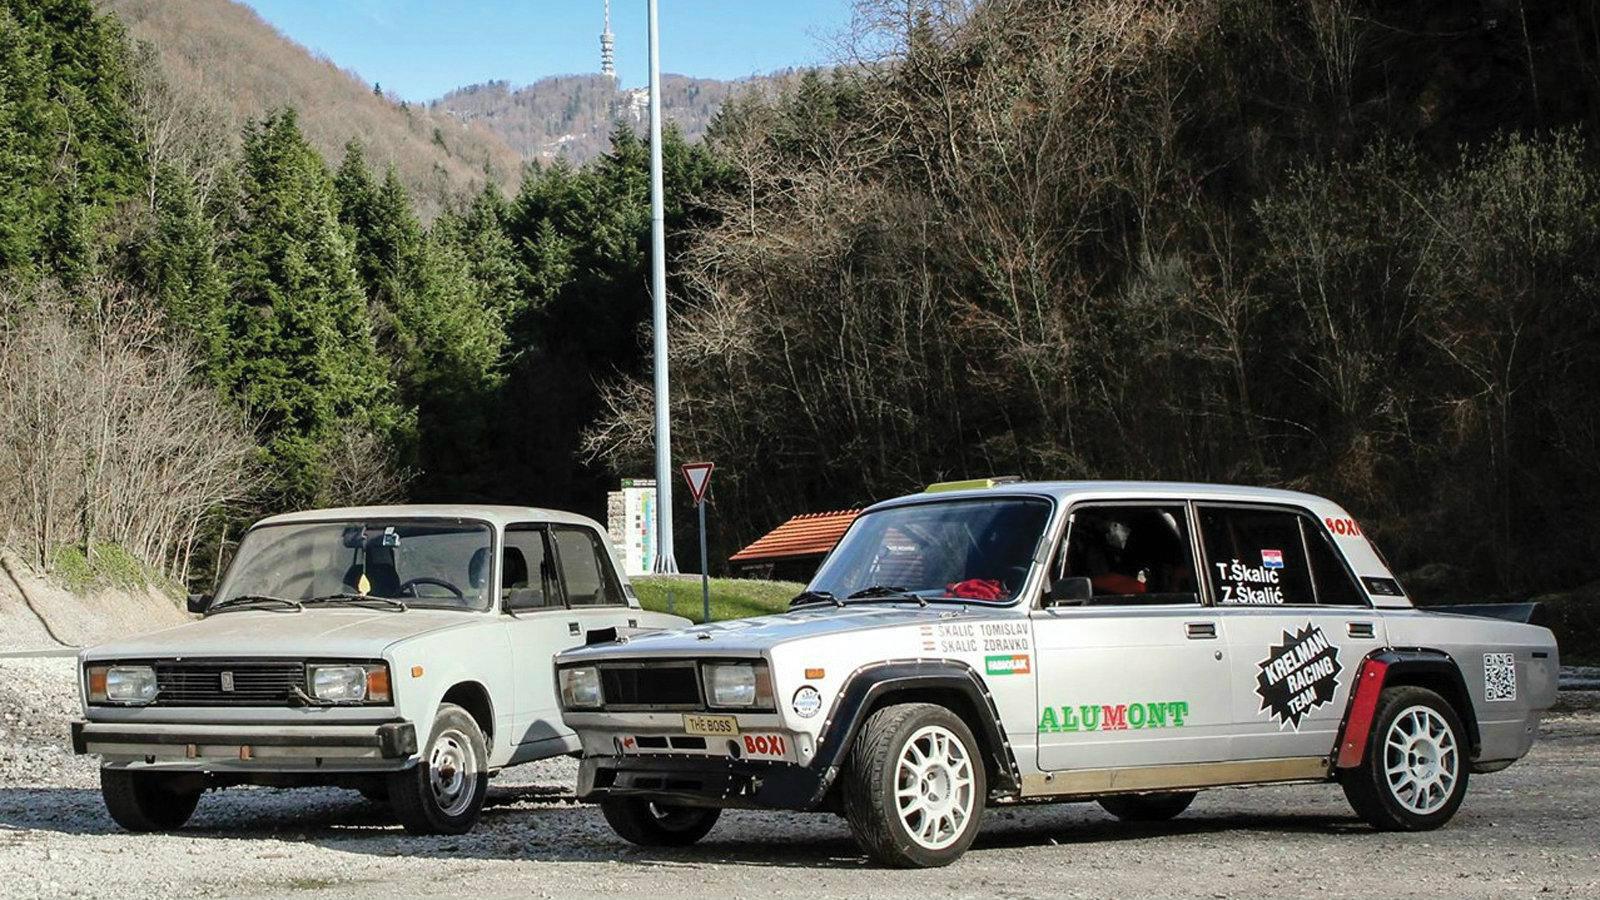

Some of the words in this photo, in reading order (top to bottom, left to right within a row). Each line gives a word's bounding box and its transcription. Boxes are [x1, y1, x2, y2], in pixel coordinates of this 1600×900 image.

[1221, 582, 1284, 604] Z.Škalić
[980, 623, 1028, 636] TOMISLAV
[984, 638, 1029, 652] ZDRAVKO
[1264, 630, 1329, 685] KRELMAN
[1286, 656, 1334, 694] RACING
[1287, 685, 1317, 714] TEAM
[689, 718, 706, 730] THE
[707, 719, 732, 732] BOSS
[1038, 701, 1189, 732] ALUMONT
[743, 735, 785, 756] BOXI
